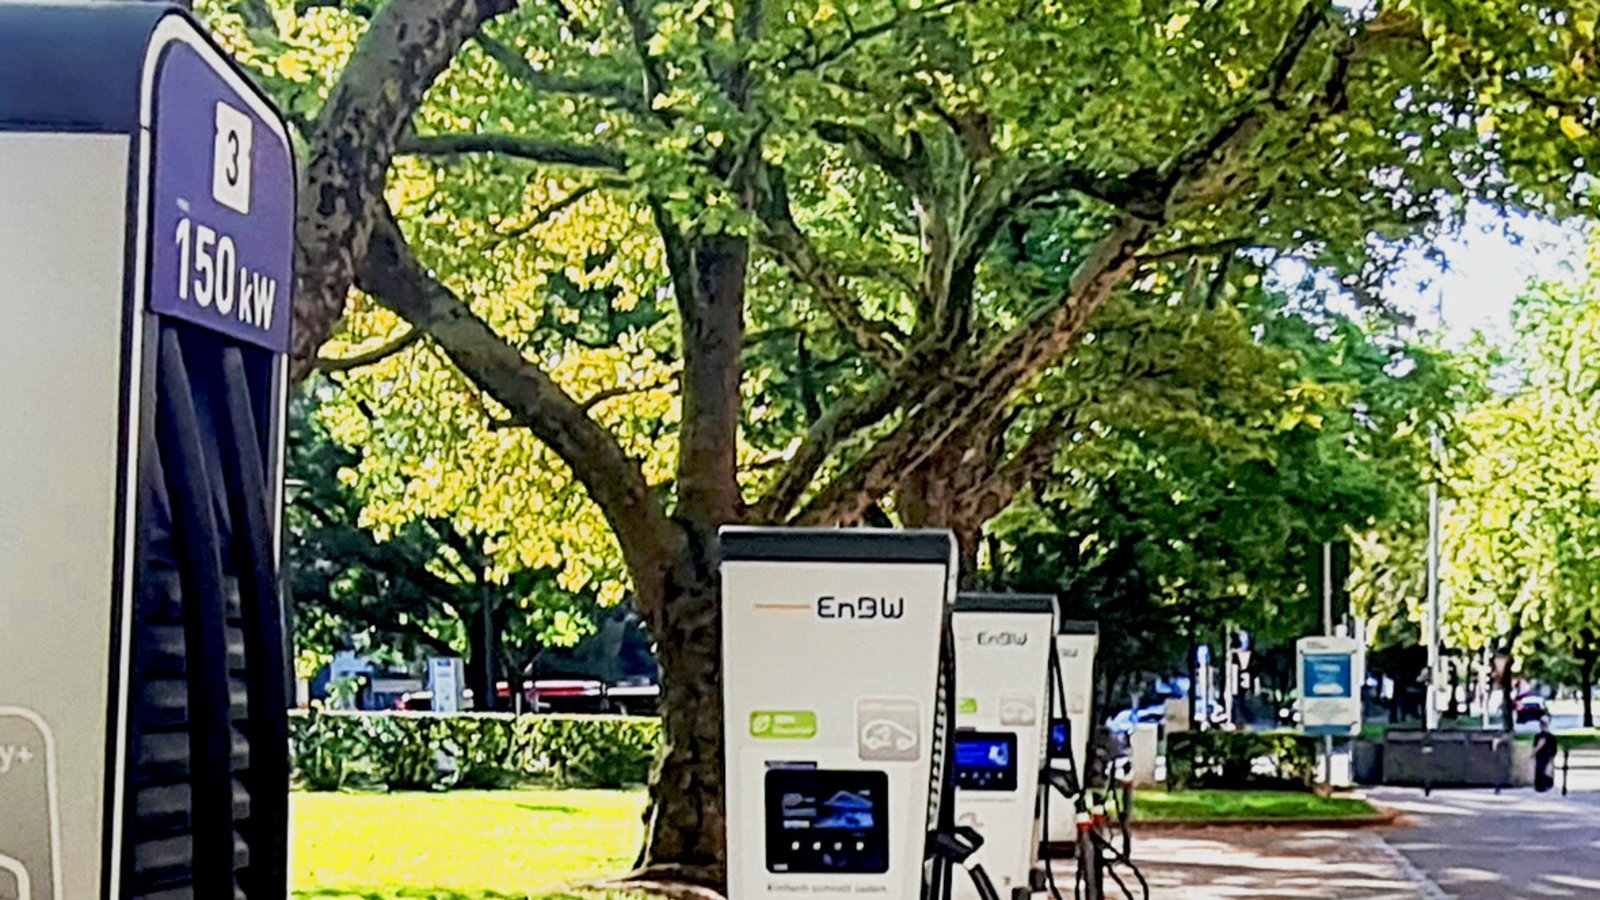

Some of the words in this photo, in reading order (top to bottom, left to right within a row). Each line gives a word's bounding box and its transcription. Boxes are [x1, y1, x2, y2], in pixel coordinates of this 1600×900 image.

[226, 129, 240, 188] 3
[175, 217, 236, 316] 150
[238, 266, 277, 331] kW
[817, 596, 904, 619] EnBW
